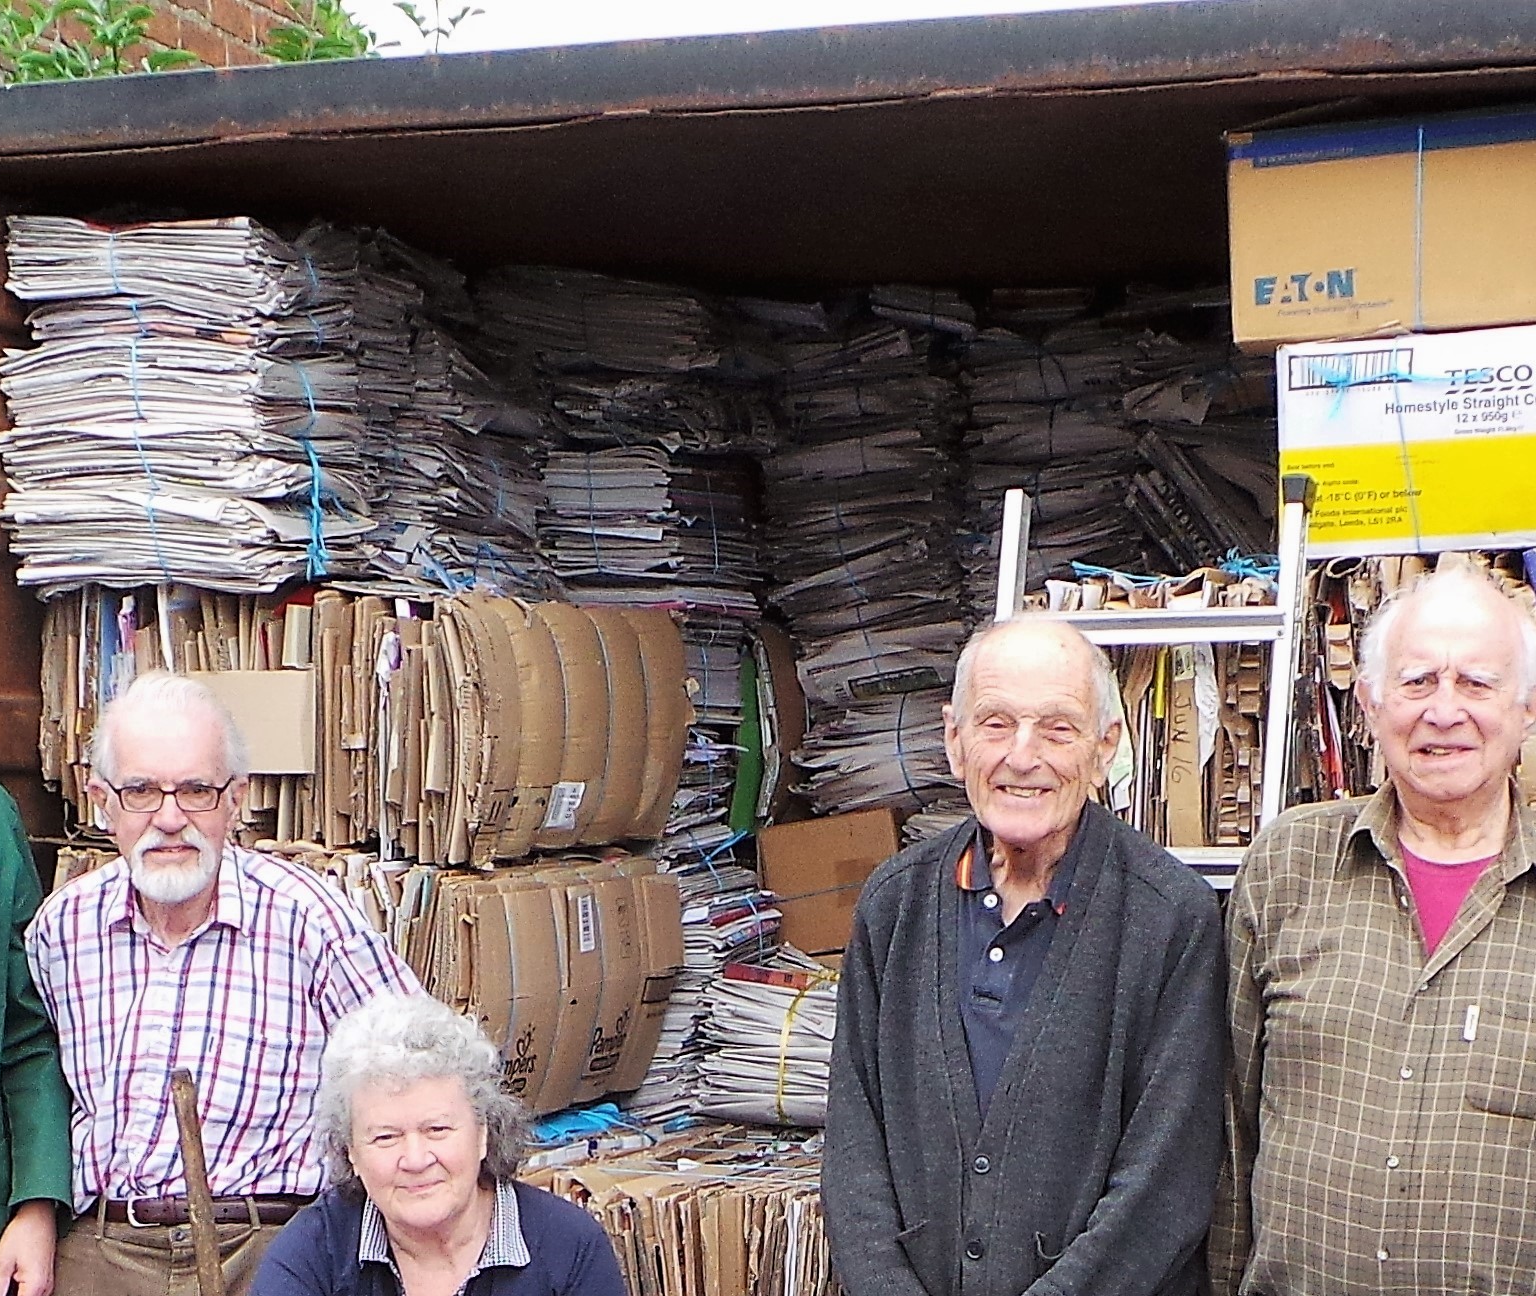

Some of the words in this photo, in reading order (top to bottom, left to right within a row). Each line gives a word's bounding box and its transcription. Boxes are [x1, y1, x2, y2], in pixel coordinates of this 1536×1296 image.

[1254, 268, 1355, 306] EATON
[1444, 364, 1533, 386] TESCO
[1384, 398, 1459, 416] Homestyle
[1463, 395, 1520, 411] Straight
[1456, 412, 1469, 423] 12
[1472, 413, 1478, 422] x
[1481, 411, 1508, 423] 950g
[1379, 491, 1390, 500] or
